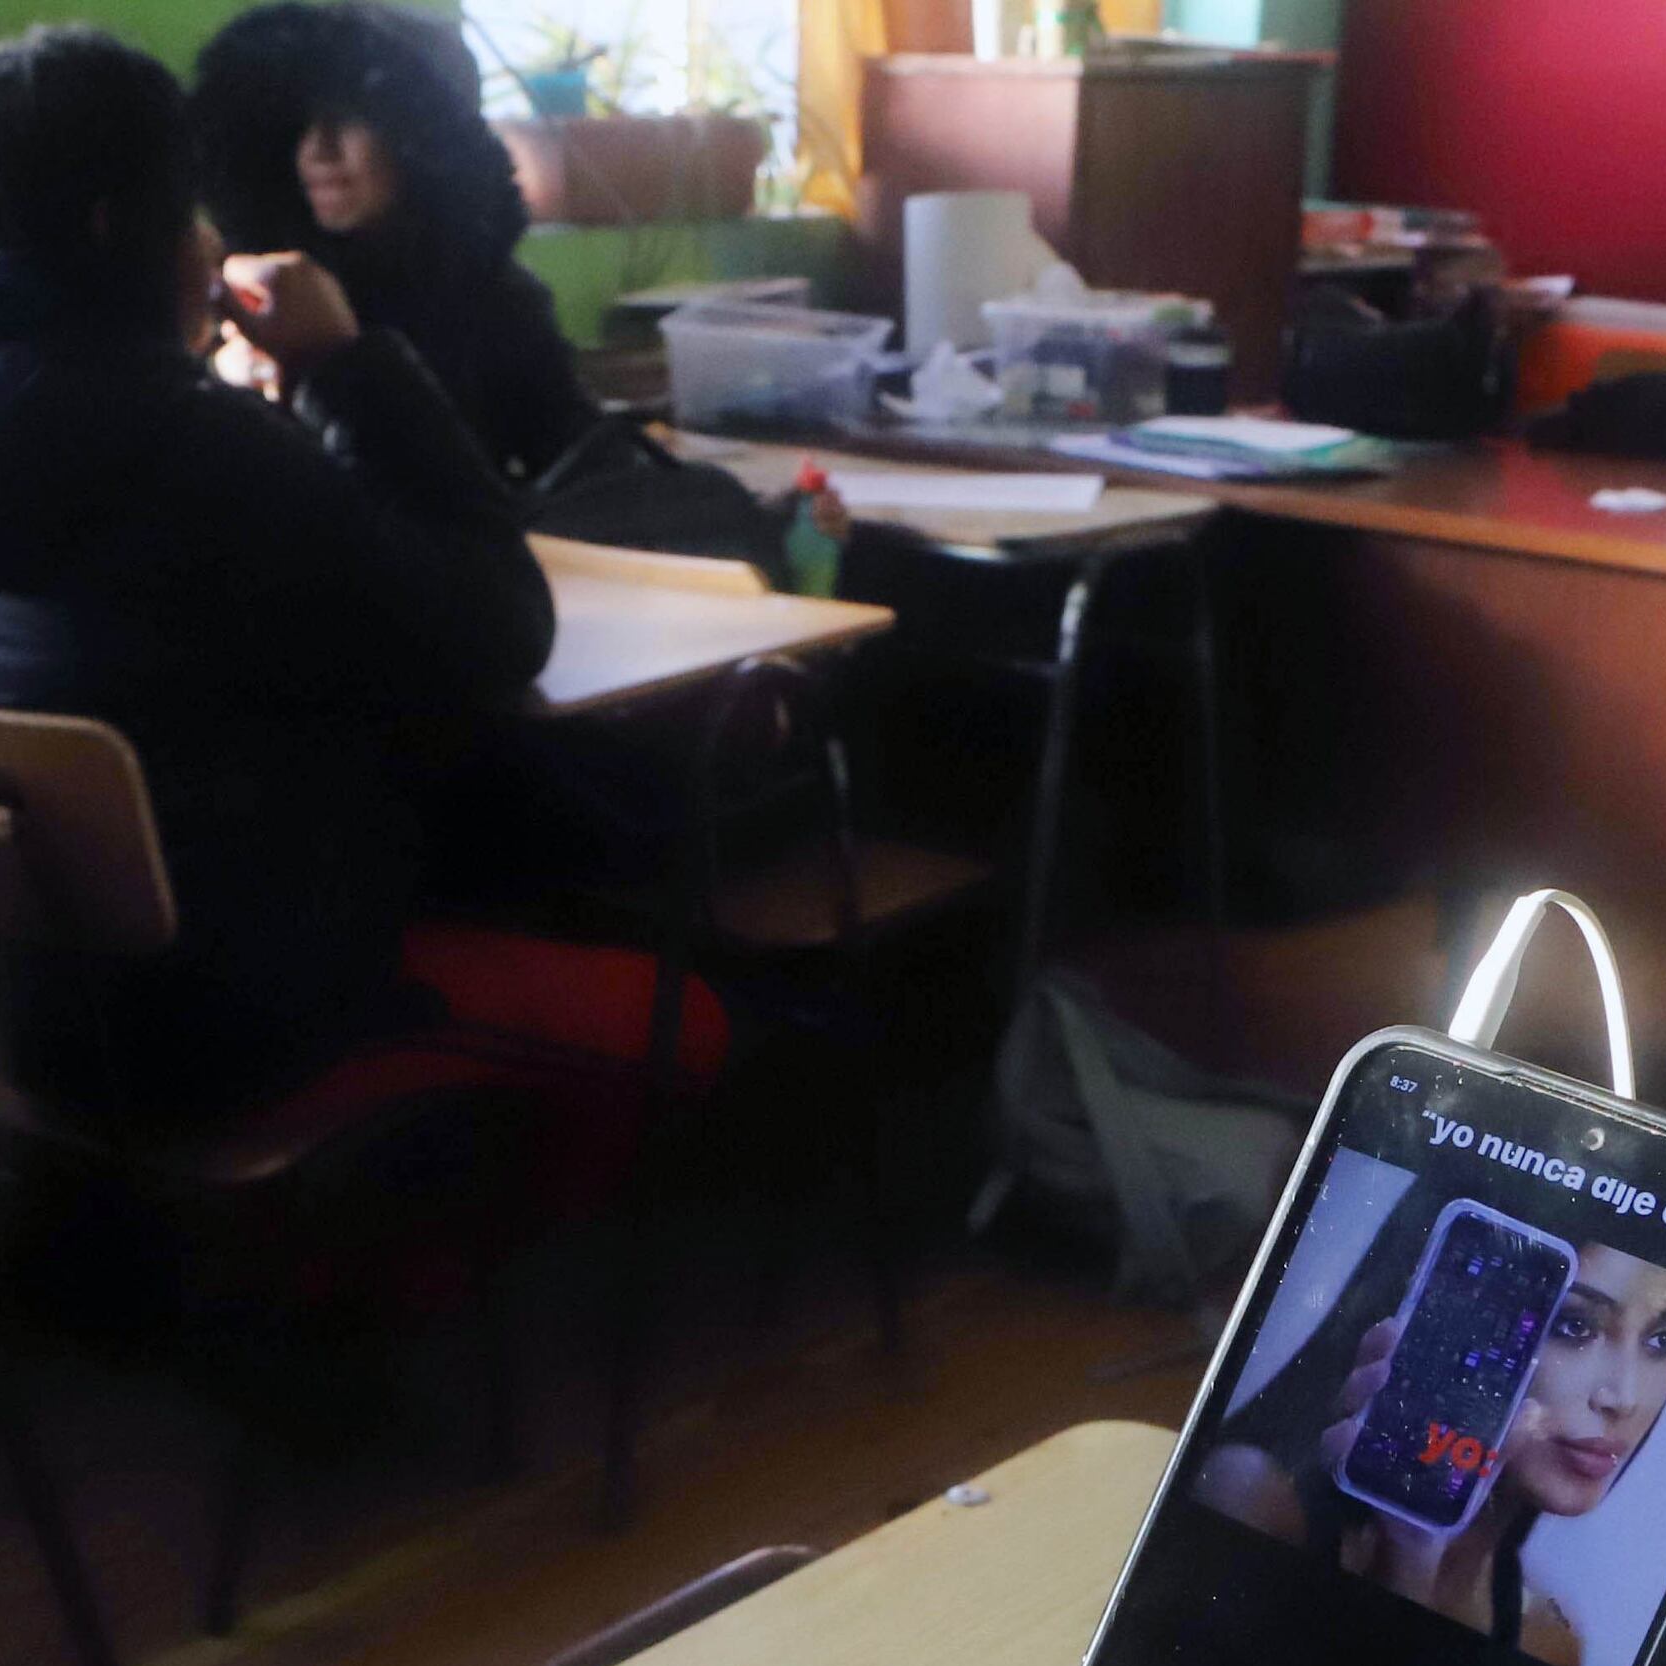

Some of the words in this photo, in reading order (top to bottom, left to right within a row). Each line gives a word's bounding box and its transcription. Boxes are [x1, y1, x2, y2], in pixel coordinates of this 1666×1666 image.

[1390, 1075, 1418, 1093] 8:37
[1477, 1132, 1586, 1191] nunca
[1590, 1174, 1657, 1215] dije
[1419, 1421, 1499, 1478] yo:
